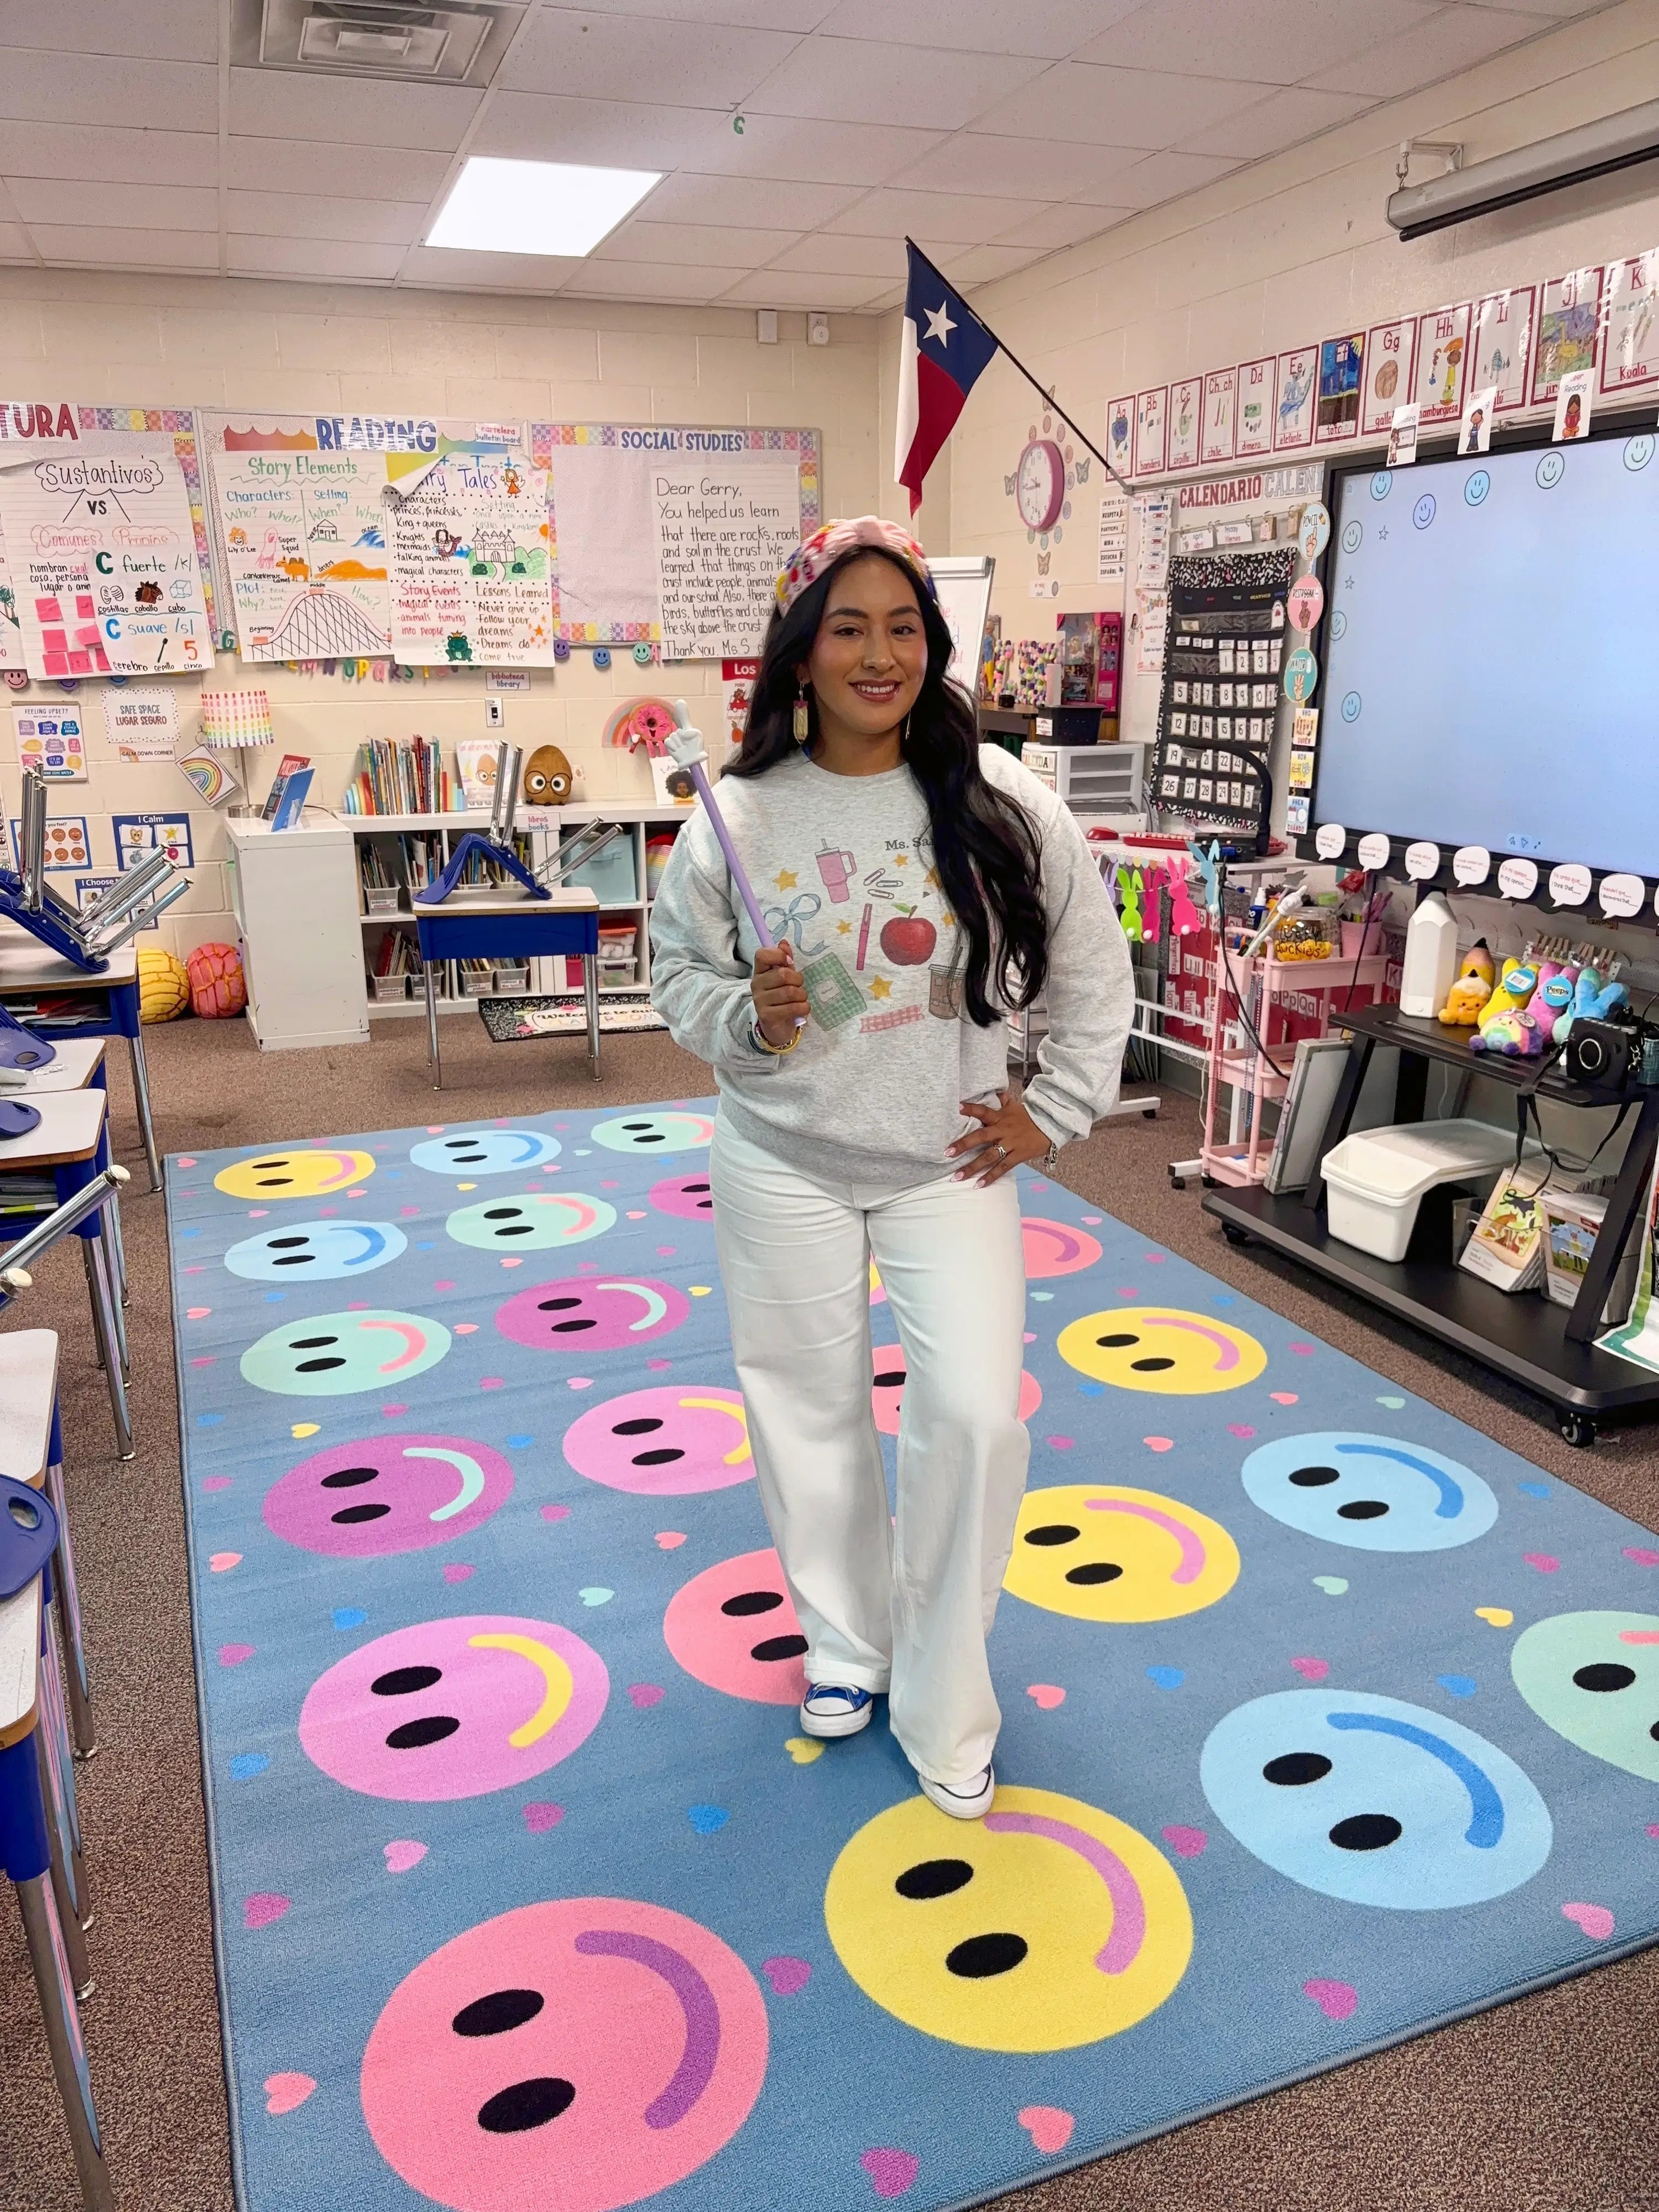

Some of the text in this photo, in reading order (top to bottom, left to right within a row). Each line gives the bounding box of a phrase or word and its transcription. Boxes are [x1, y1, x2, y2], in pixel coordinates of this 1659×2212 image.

[1436, 317, 1454, 339] Hh
[1383, 331, 1400, 352] Gg
[1289, 356, 1303, 375] Ee
[1251, 366, 1263, 384] Dd
[1564, 383, 1587, 394] Reading
[1146, 395, 1157, 411] Bb
[502, 435, 521, 444] board
[621, 430, 743, 452] SOCIAL STUDIES
[1241, 441, 1261, 451] dinero
[46, 460, 153, 484] Sustantivos
[248, 456, 357, 483] Story Elements
[457, 468, 498, 489] Tales
[656, 477, 742, 499] Dear Gerry,
[1180, 474, 1262, 508] CALENDARIO
[398, 495, 446, 505] Characters
[225, 506, 303, 524] Who? What?
[308, 504, 341, 522] When?
[658, 500, 780, 524] You helped us learn
[422, 520, 447, 530] queens
[40, 527, 97, 548] Comunes
[661, 525, 684, 542] that
[690, 526, 717, 542] there
[720, 531, 737, 541] are
[776, 526, 800, 541] roots
[397, 542, 431, 551] mermaids
[662, 539, 784, 559] and soil in the crust We
[30, 562, 67, 573] nombran
[96, 551, 166, 575] C fuerte
[661, 558, 774, 576] learned that things on
[398, 566, 463, 578] magical characters
[662, 573, 682, 588] crust
[685, 575, 714, 588] include
[40, 583, 64, 596] lugar
[400, 582, 461, 599] Story Events
[476, 584, 549, 598] Lessons Learned
[238, 597, 265, 612] Why?
[352, 585, 382, 610] How?
[98, 603, 186, 613] costillas caballo cubo
[478, 603, 540, 615] Never give up
[400, 612, 466, 626] animals turning
[479, 614, 530, 627] Follow your
[106, 618, 167, 640] C suave
[249, 625, 274, 634] Beginning
[401, 627, 444, 637] into people
[478, 626, 514, 637] dreams
[663, 619, 762, 638] the sky above the crust
[184, 640, 198, 660] 5
[481, 638, 530, 649] Dreams do
[664, 640, 696, 657] Thank
[507, 653, 525, 662] true
[113, 661, 148, 672] cerebro
[154, 662, 175, 671] cepillo
[734, 664, 756, 675] Los
[497, 680, 520, 690] library
[1177, 685, 1183, 698] 5
[1223, 688, 1229, 701] 8
[119, 704, 160, 714] SAFE SPACE
[116, 716, 167, 726] LUGAR SEGURO
[1175, 717, 1182, 729] 12
[1220, 755, 1229, 767] 22
[1164, 780, 1175, 792] 26
[143, 815, 164, 823] Calm
[885, 839, 909, 851] Ms.
[1275, 941, 1321, 958] duckies
[1545, 985, 1570, 995] Peeps
[1282, 990, 1296, 1008] Pp
[1300, 997, 1315, 1014] Qq
